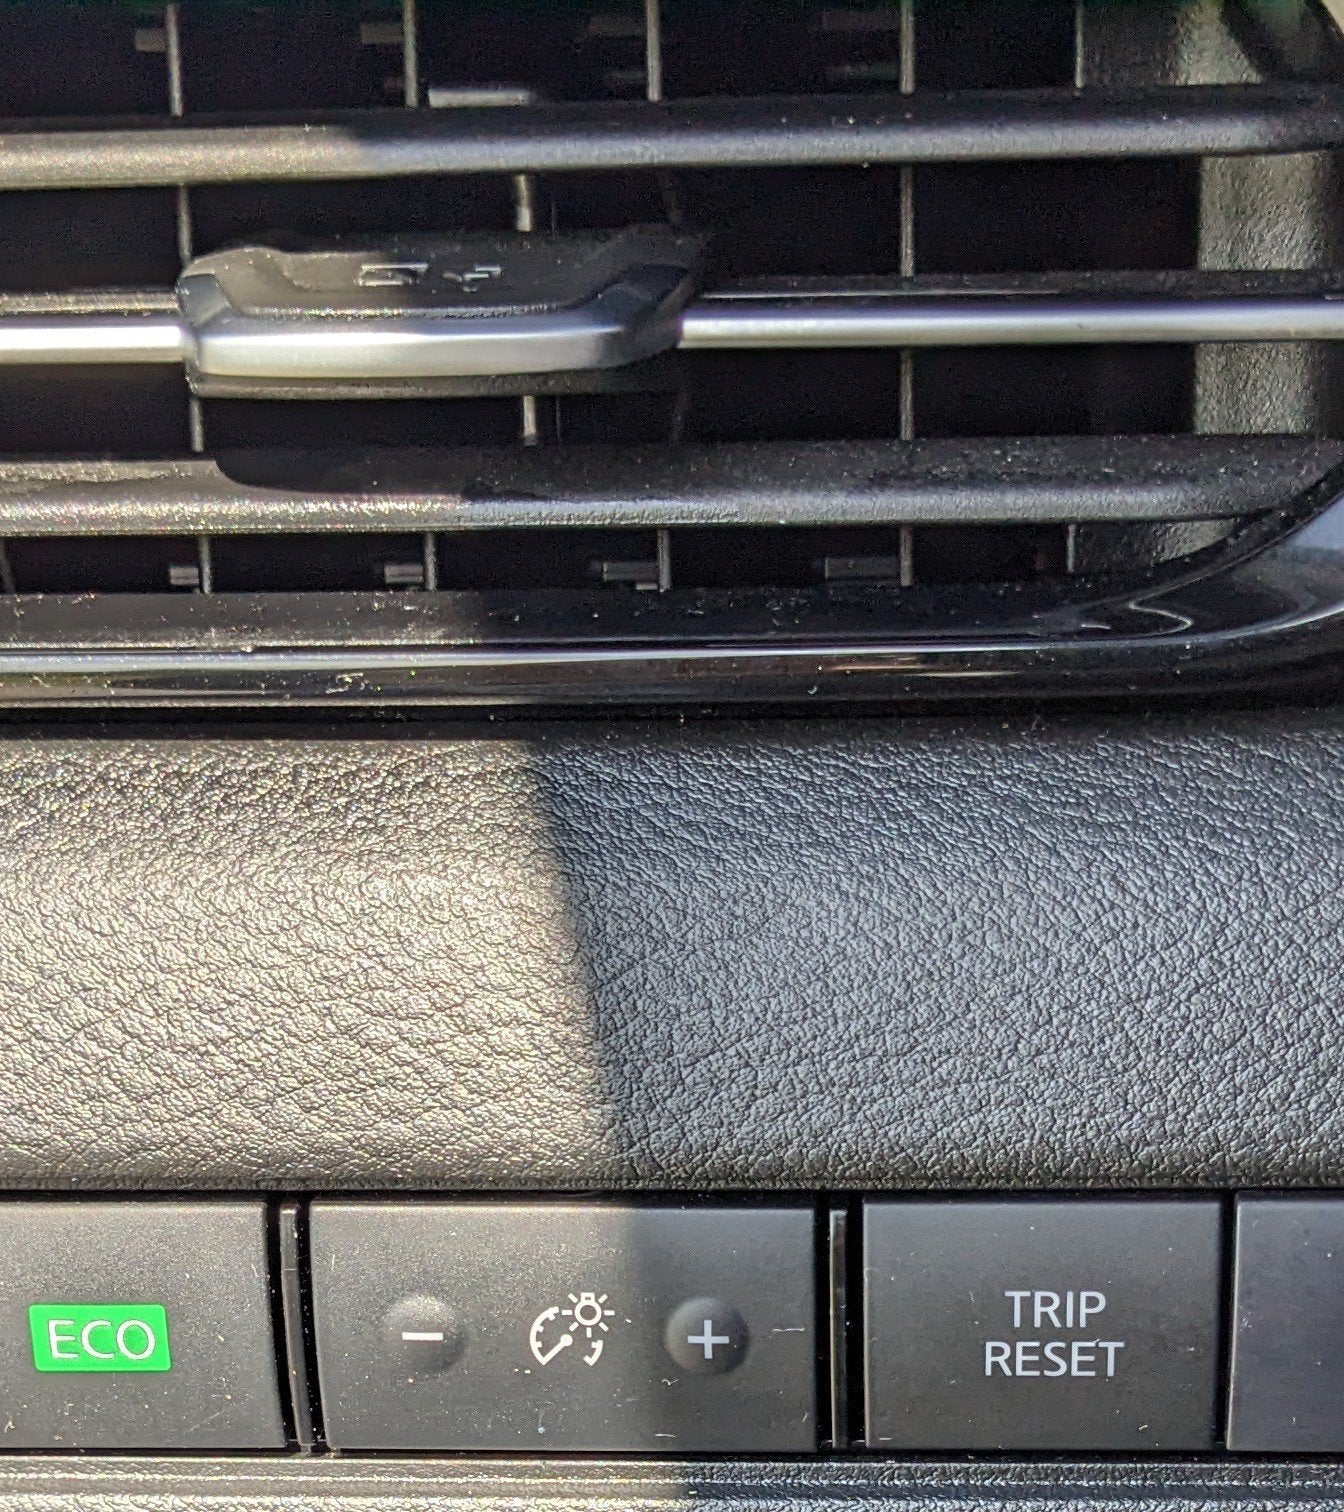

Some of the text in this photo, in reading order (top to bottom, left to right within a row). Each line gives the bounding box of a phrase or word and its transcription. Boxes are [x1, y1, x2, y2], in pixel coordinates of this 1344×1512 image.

[1004, 1290, 1107, 1328] TRIP
[47, 1319, 156, 1360] ECO
[984, 1339, 1125, 1378] RESET
